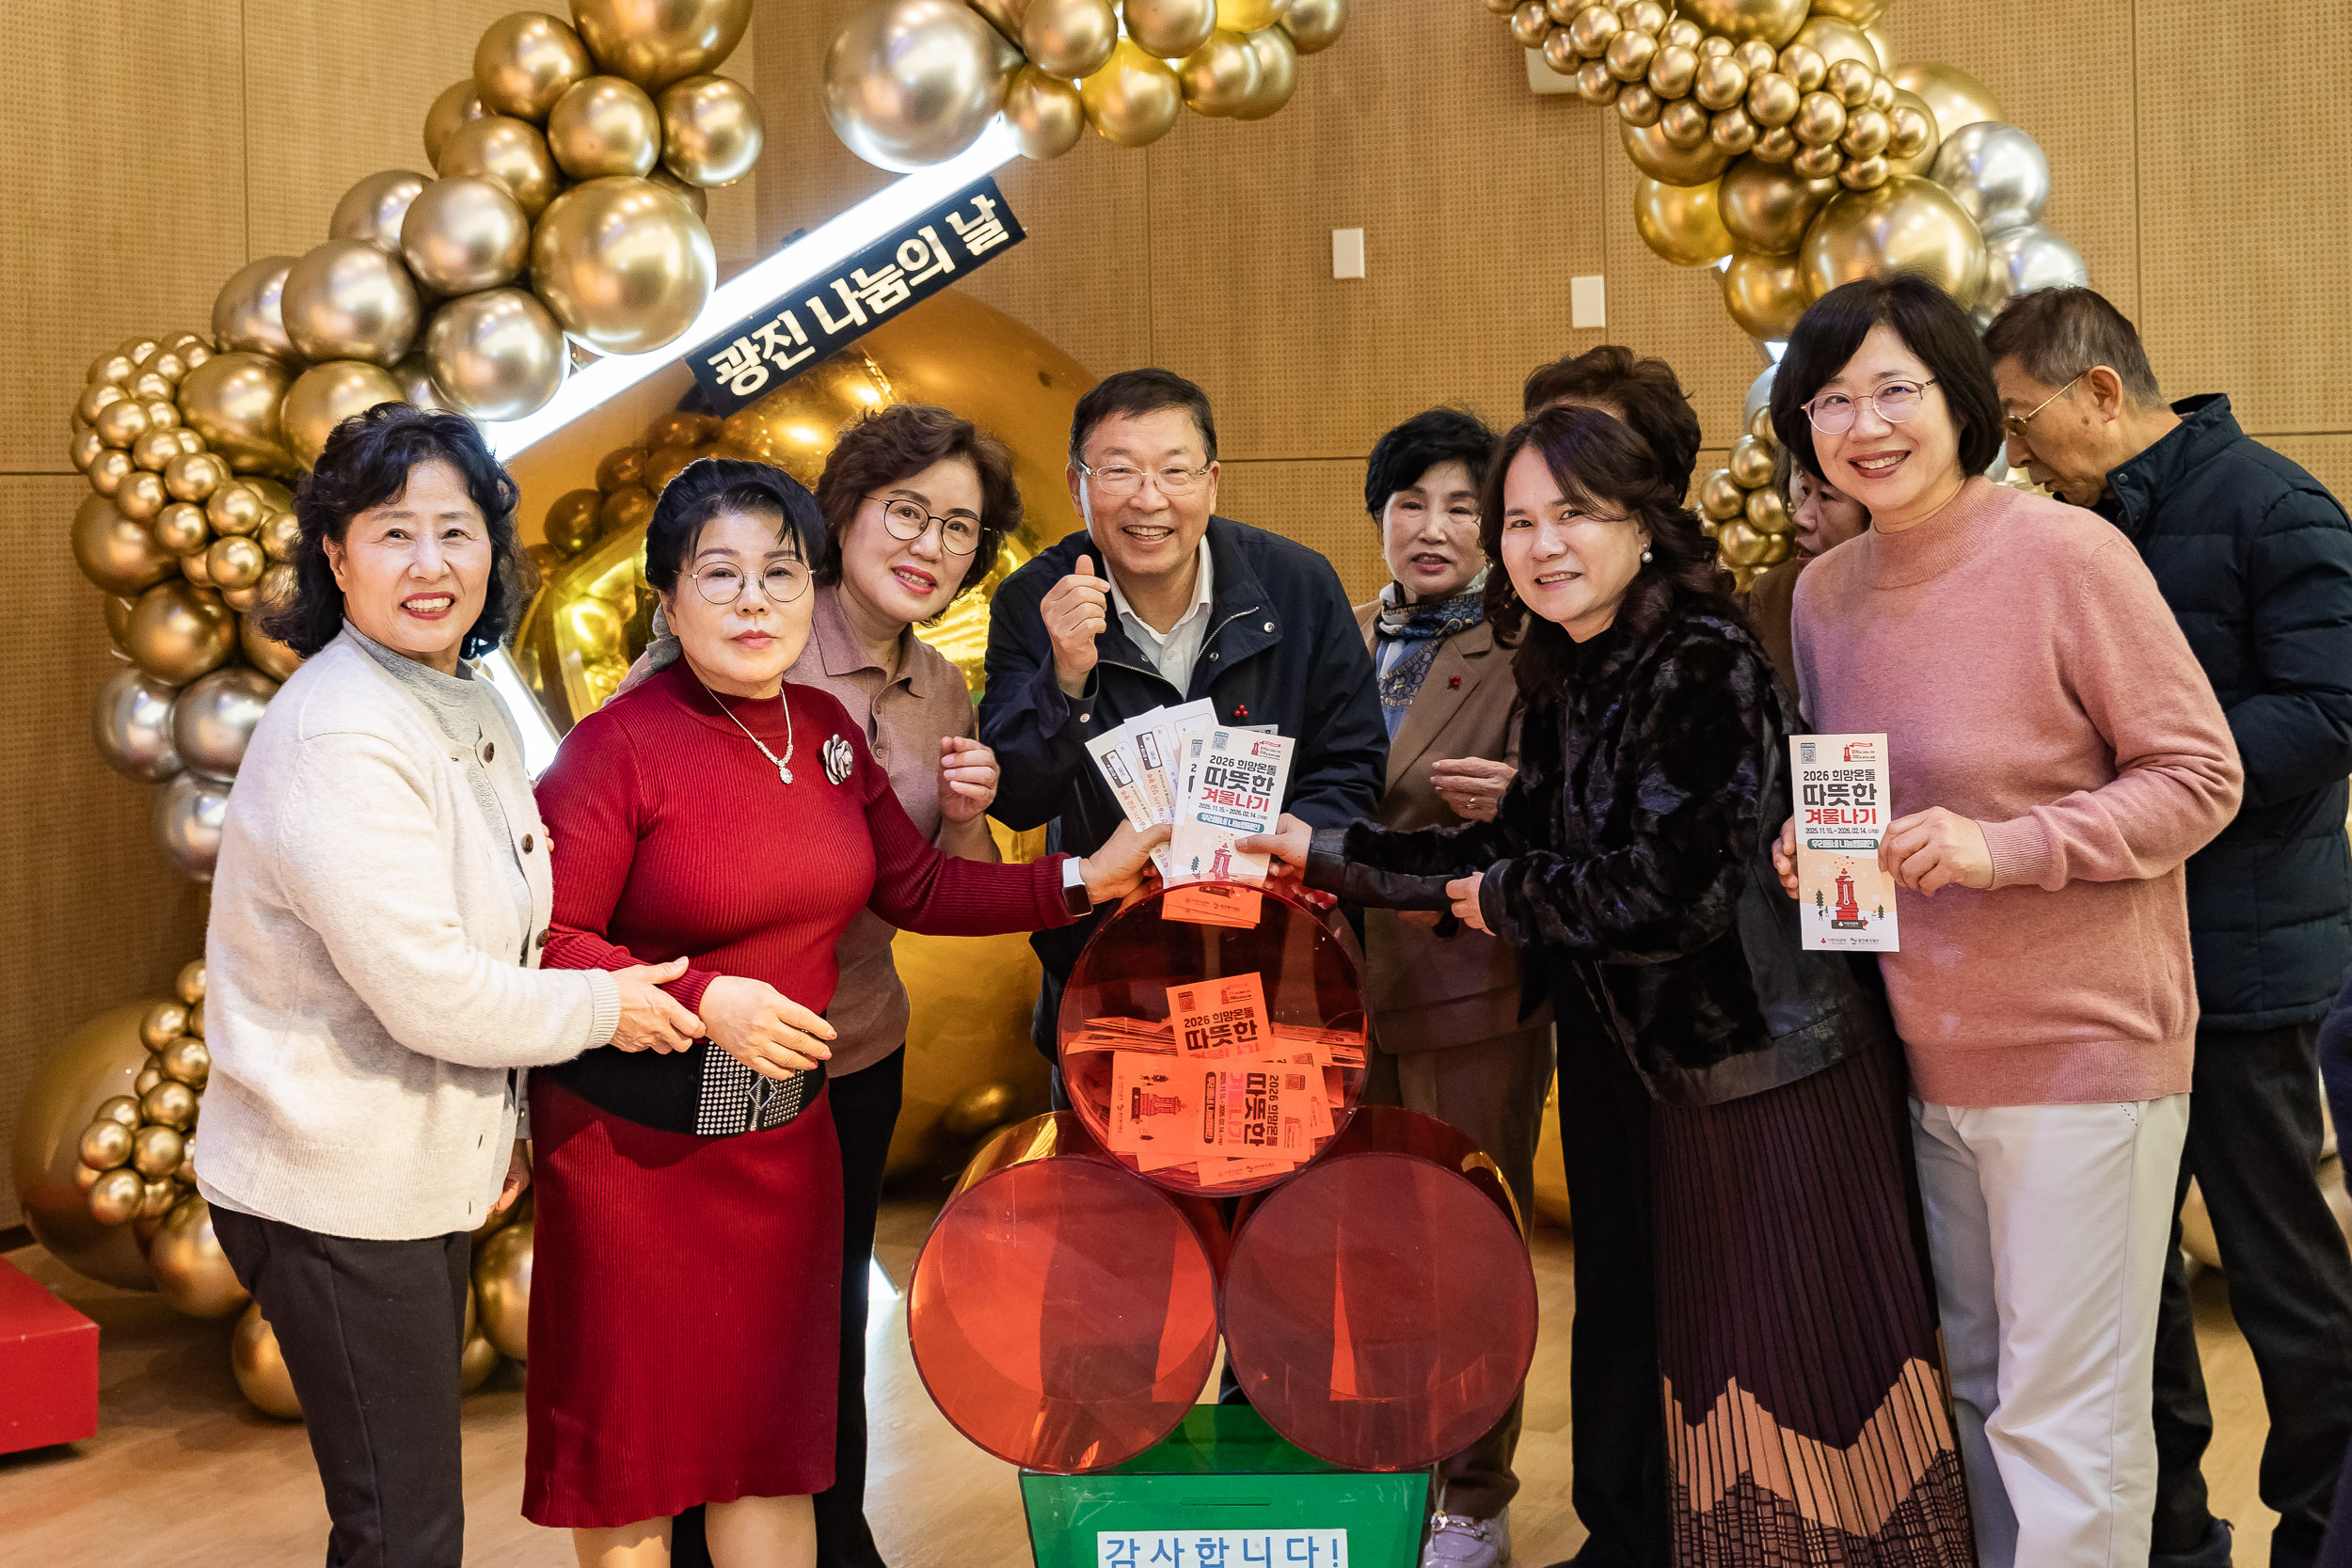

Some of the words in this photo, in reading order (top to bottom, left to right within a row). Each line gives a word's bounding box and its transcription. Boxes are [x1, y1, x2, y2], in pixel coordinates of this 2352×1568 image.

[707, 309, 816, 396] 광진
[805, 225, 956, 335] 나눔의
[945, 194, 1009, 256] 날
[1210, 754, 1234, 768] 2026
[1236, 759, 1277, 776] 희망온돌
[1804, 770, 1829, 781] 2026
[1832, 769, 1875, 782] 희망온돌
[1204, 767, 1274, 796] 따뜻한
[1803, 783, 1877, 806] 따뜻한
[1201, 787, 1269, 812] 겨울나기
[1804, 808, 1876, 824] 겨울나기
[1184, 1015, 1210, 1028] 2026
[1213, 1006, 1254, 1023] 희망온돌
[1185, 1020, 1258, 1051] 따뜻한
[1269, 1075, 1279, 1101] 2026
[1227, 1072, 1243, 1144] 겨울나기
[1245, 1072, 1266, 1147] 따뜻한
[1266, 1104, 1279, 1147] 희망온돌
[1104, 1536, 1339, 1568] 감사합니다!
